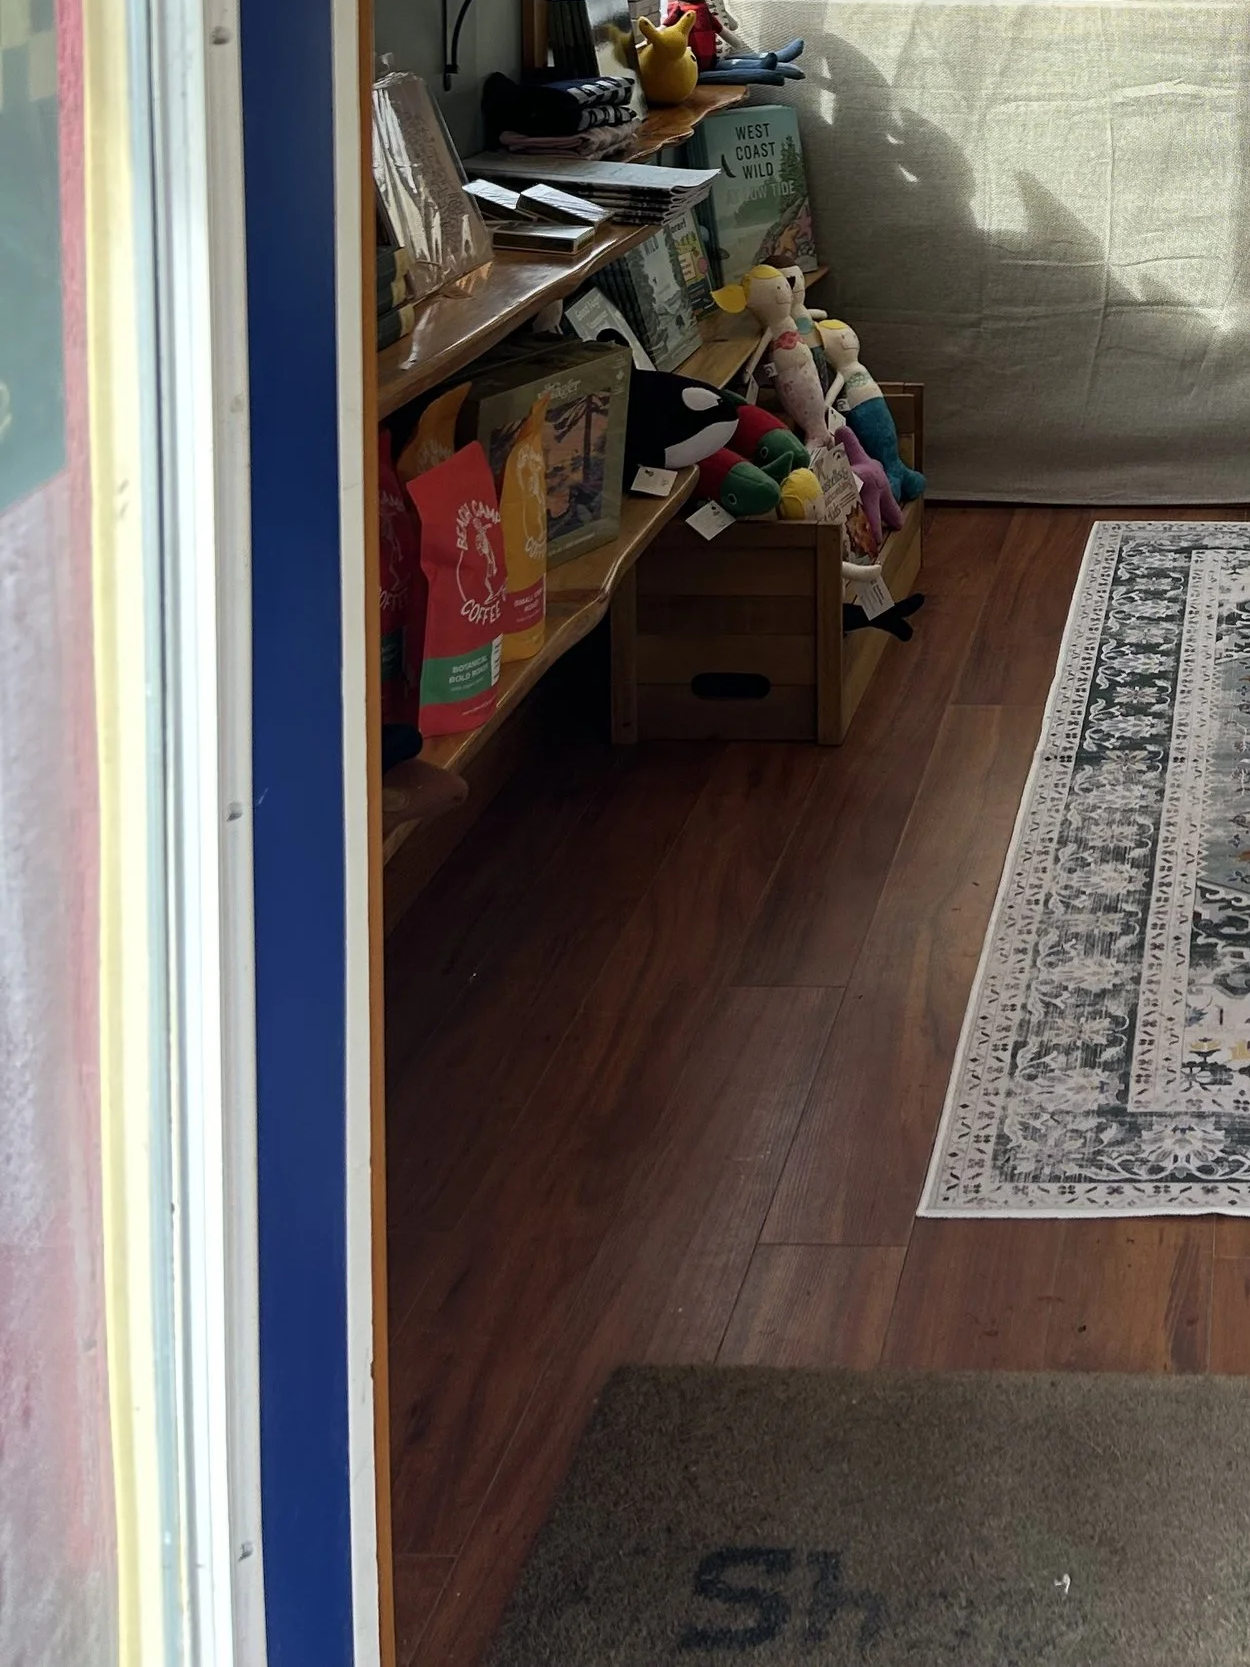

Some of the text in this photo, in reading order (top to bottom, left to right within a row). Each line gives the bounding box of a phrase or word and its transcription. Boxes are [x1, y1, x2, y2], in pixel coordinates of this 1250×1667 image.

[735, 122, 771, 141] WEST
[735, 141, 776, 162] COAST
[741, 161, 774, 181] WILD
[770, 179, 796, 198] TIDE
[456, 499, 501, 551] BEACH CAMP
[460, 598, 501, 627] COFFEE
